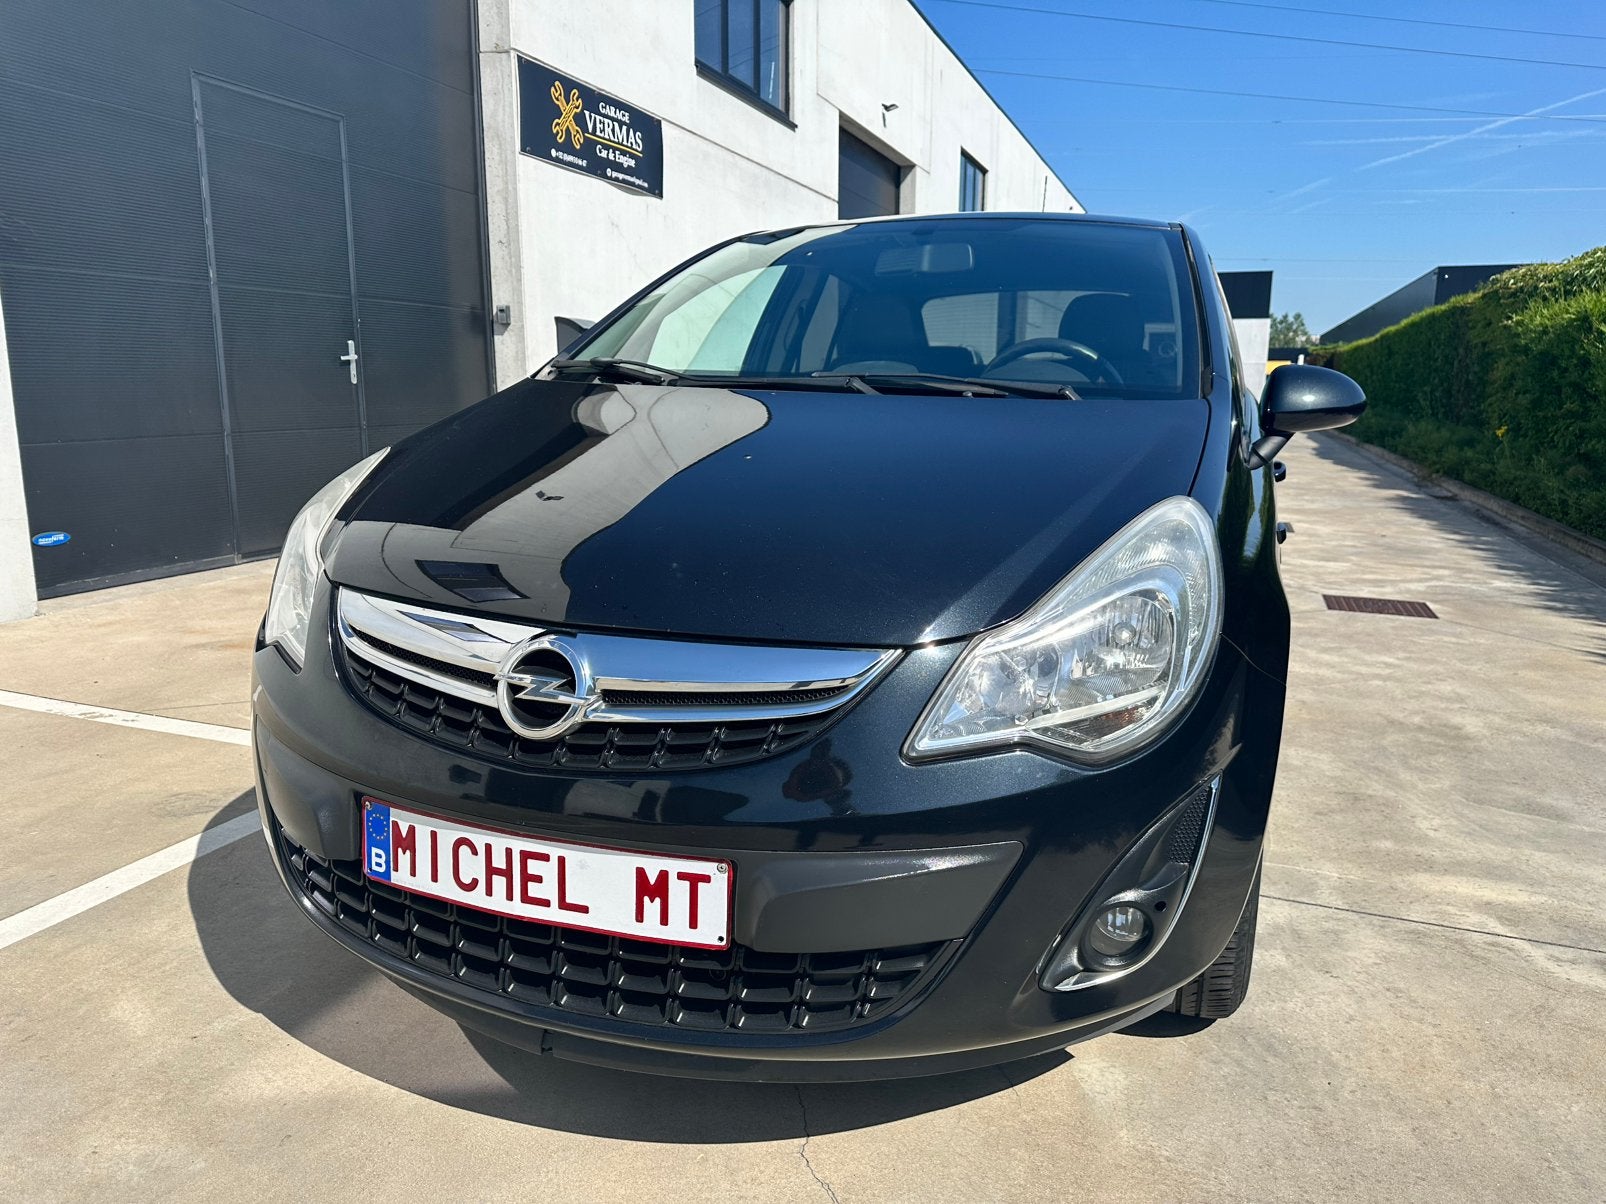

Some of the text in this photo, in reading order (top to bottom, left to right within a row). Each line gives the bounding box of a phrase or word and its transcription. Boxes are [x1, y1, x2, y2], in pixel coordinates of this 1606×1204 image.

[599, 102, 630, 123] GARAGE
[584, 110, 643, 151] VERMAS
[596, 144, 636, 168] Car & Engine
[371, 847, 386, 873] B
[391, 820, 711, 930] MICHEL MT
